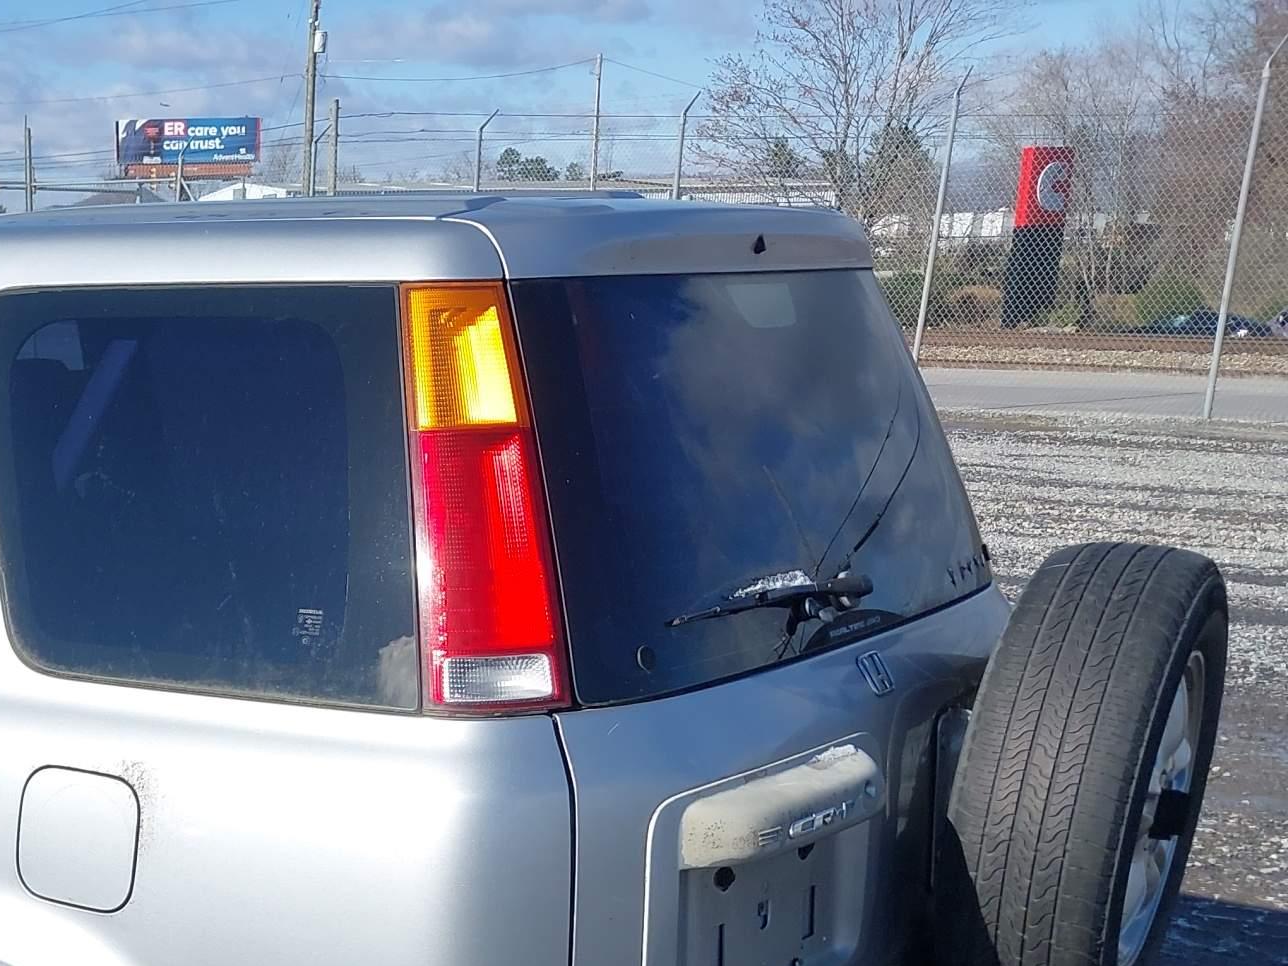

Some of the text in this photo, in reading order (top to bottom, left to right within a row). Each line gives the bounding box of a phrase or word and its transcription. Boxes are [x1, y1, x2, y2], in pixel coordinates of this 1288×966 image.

[164, 122, 246, 139] ER care you
[163, 138, 225, 151] can trust.
